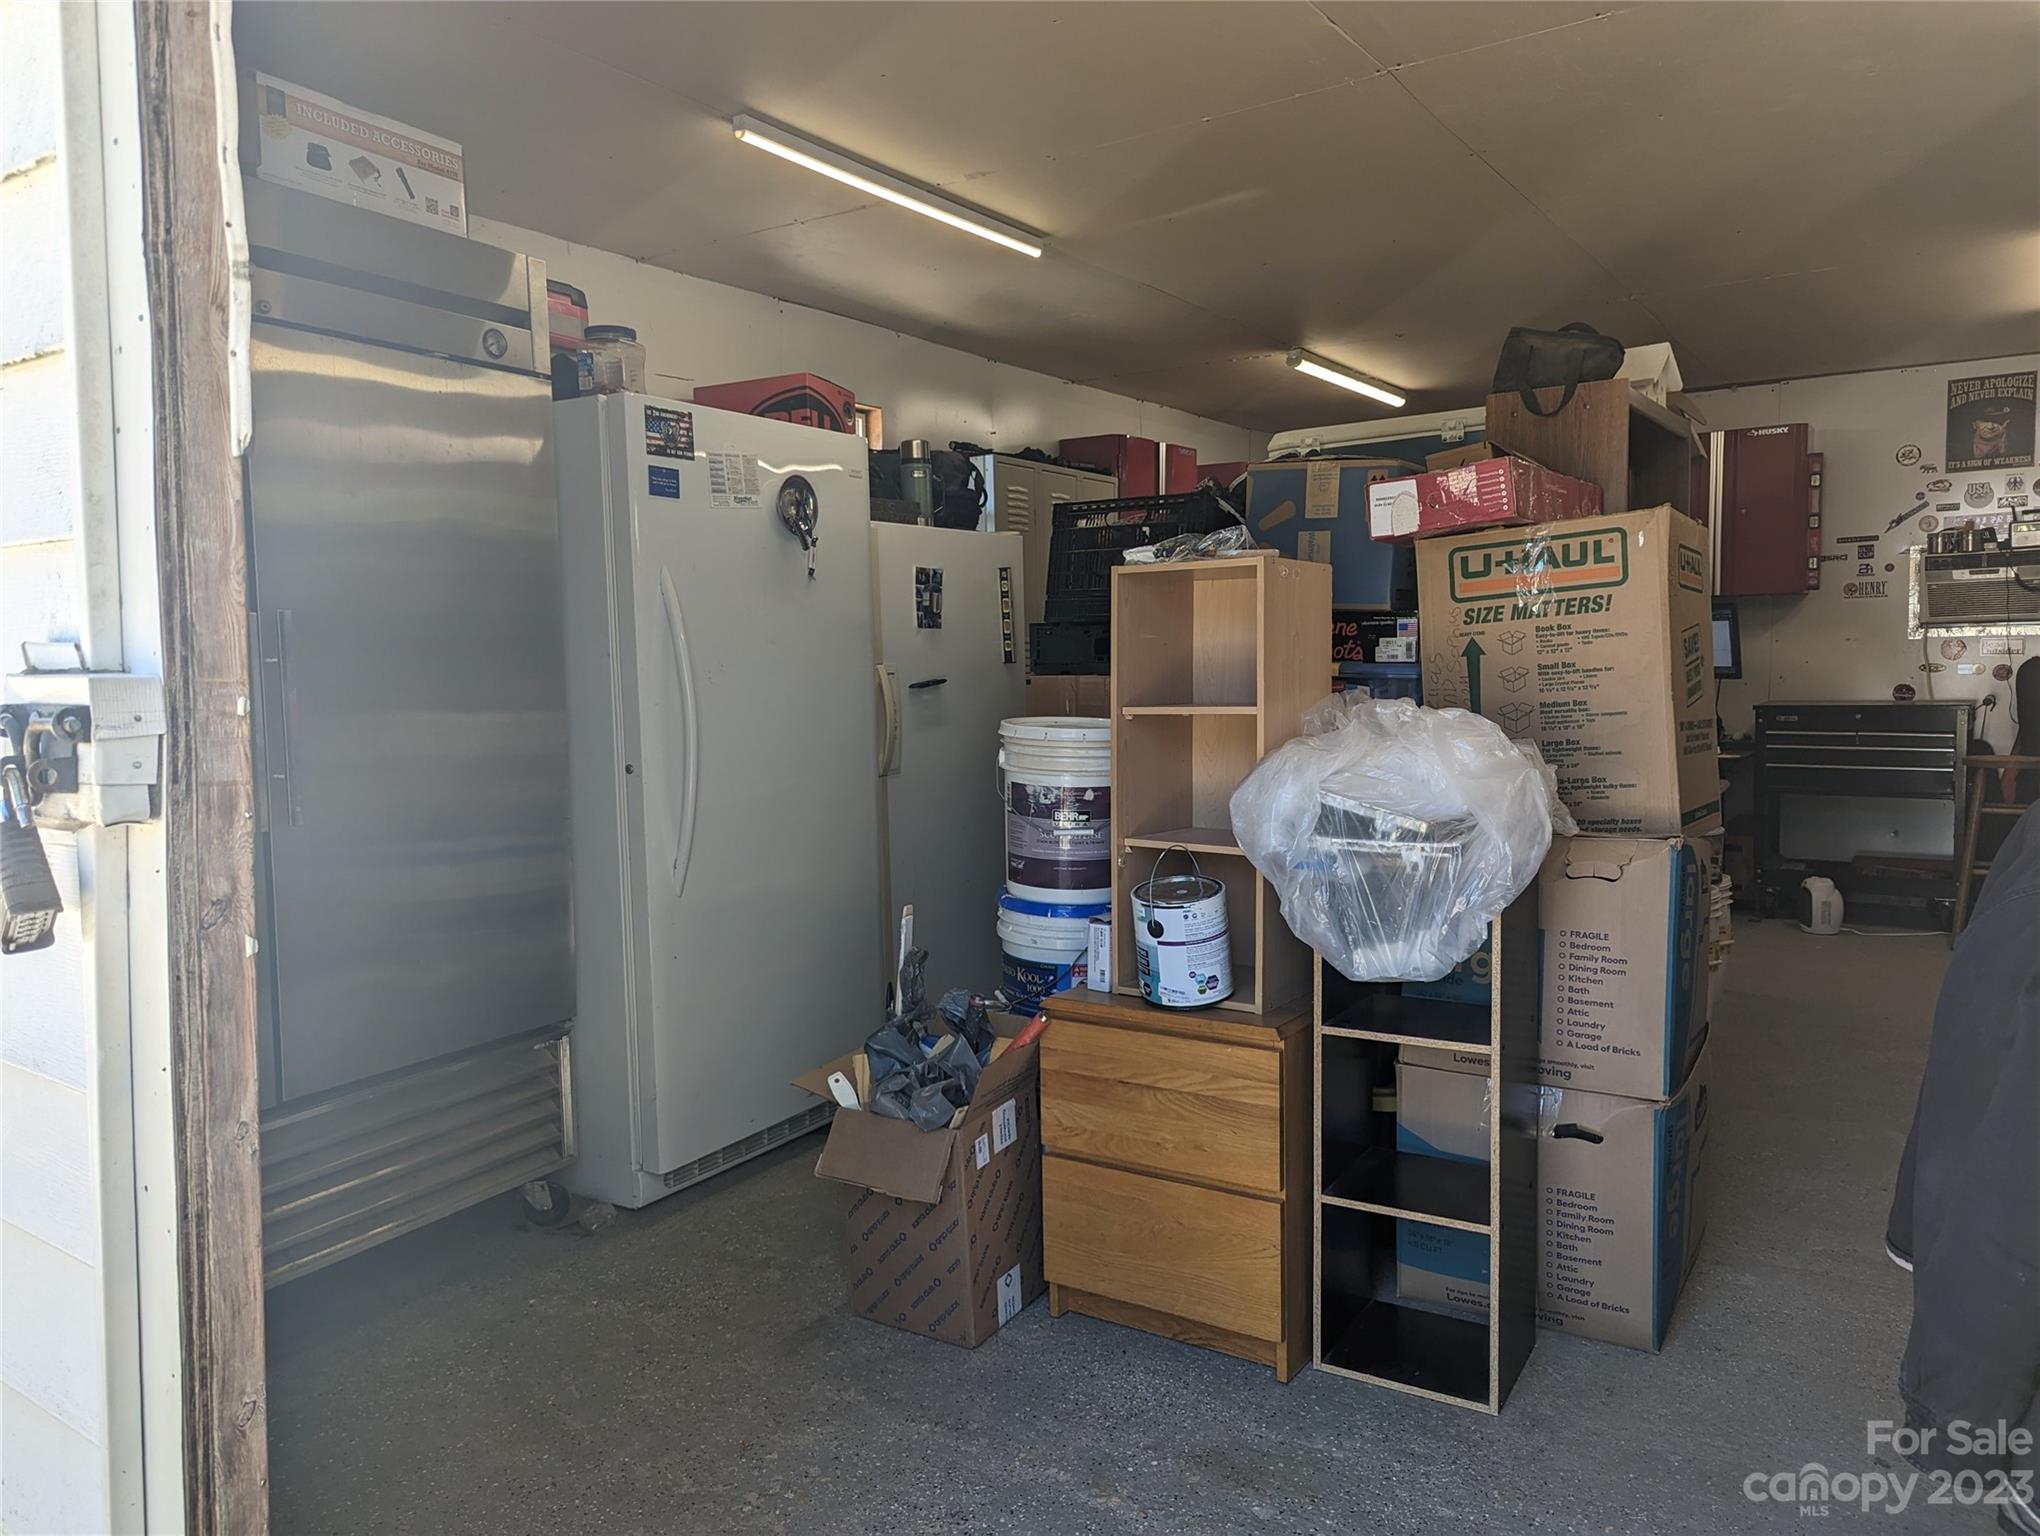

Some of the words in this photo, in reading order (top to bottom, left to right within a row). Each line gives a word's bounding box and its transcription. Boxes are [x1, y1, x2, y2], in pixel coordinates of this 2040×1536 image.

[295, 103, 369, 138] INCLUDED
[372, 130, 459, 170] ACCESSORIES
[1950, 380, 1981, 396] NEVER
[1984, 375, 2035, 389] APOLOGIZE
[1950, 394, 1968, 409] AND
[1968, 389, 1996, 401] NEVER
[1998, 388, 2034, 400] EXPLAIN
[1758, 427, 1789, 436] HUSKY
[1994, 455, 2032, 465] WEAKNESS
[1967, 481, 1991, 495] USA
[1859, 581, 1886, 595] HENRY
[1463, 606, 1505, 626] SIZE
[1510, 594, 1613, 621] MATTERS!
[1535, 625, 1555, 633] Book
[1537, 662, 1559, 670] Small
[1540, 700, 1571, 709] Medium
[1541, 740, 1564, 748] Large
[1054, 811, 1079, 821] BEHR
[1569, 930, 1609, 941] FRAGILE
[1569, 942, 1611, 952] Bedroom
[1569, 953, 1599, 963] Family
[1601, 954, 1628, 965] Room
[1568, 964, 1598, 975] Dining
[1600, 966, 1627, 976] Room
[1568, 974, 1604, 985] Kitchen
[1568, 986, 1590, 995] Bath
[1567, 997, 1614, 1009] Basement
[1567, 1008, 1590, 1017] Attic
[1567, 1018, 1606, 1031] Laundry
[1566, 1029, 1602, 1041] Garage
[1566, 1041, 1574, 1049] A
[1576, 1041, 1599, 1051] Load
[1600, 1045, 1611, 1053] of
[1612, 1047, 1641, 1057] Bricks
[1453, 1053, 1490, 1067] Lowes
[1547, 1058, 1579, 1069] smoothly,
[1580, 1062, 1595, 1071] visit
[1556, 1188, 1596, 1201] FRAGILE
[1556, 1199, 1598, 1212] Bedroom
[1556, 1210, 1587, 1222] Family
[1588, 1215, 1615, 1225] Room
[1556, 1220, 1586, 1233] Dining
[1587, 1226, 1614, 1236] Room
[1556, 1231, 1592, 1243] Kitchen
[1556, 1241, 1578, 1252] Bath
[1556, 1252, 1602, 1267] Basement
[1556, 1263, 1579, 1273] Attic
[1556, 1273, 1595, 1288] Laundry
[1556, 1283, 1591, 1297] Garage
[1557, 1293, 1565, 1302] A
[1566, 1295, 1589, 1306] Load
[1590, 1300, 1601, 1308] of
[1601, 1302, 1630, 1314] Bricks
